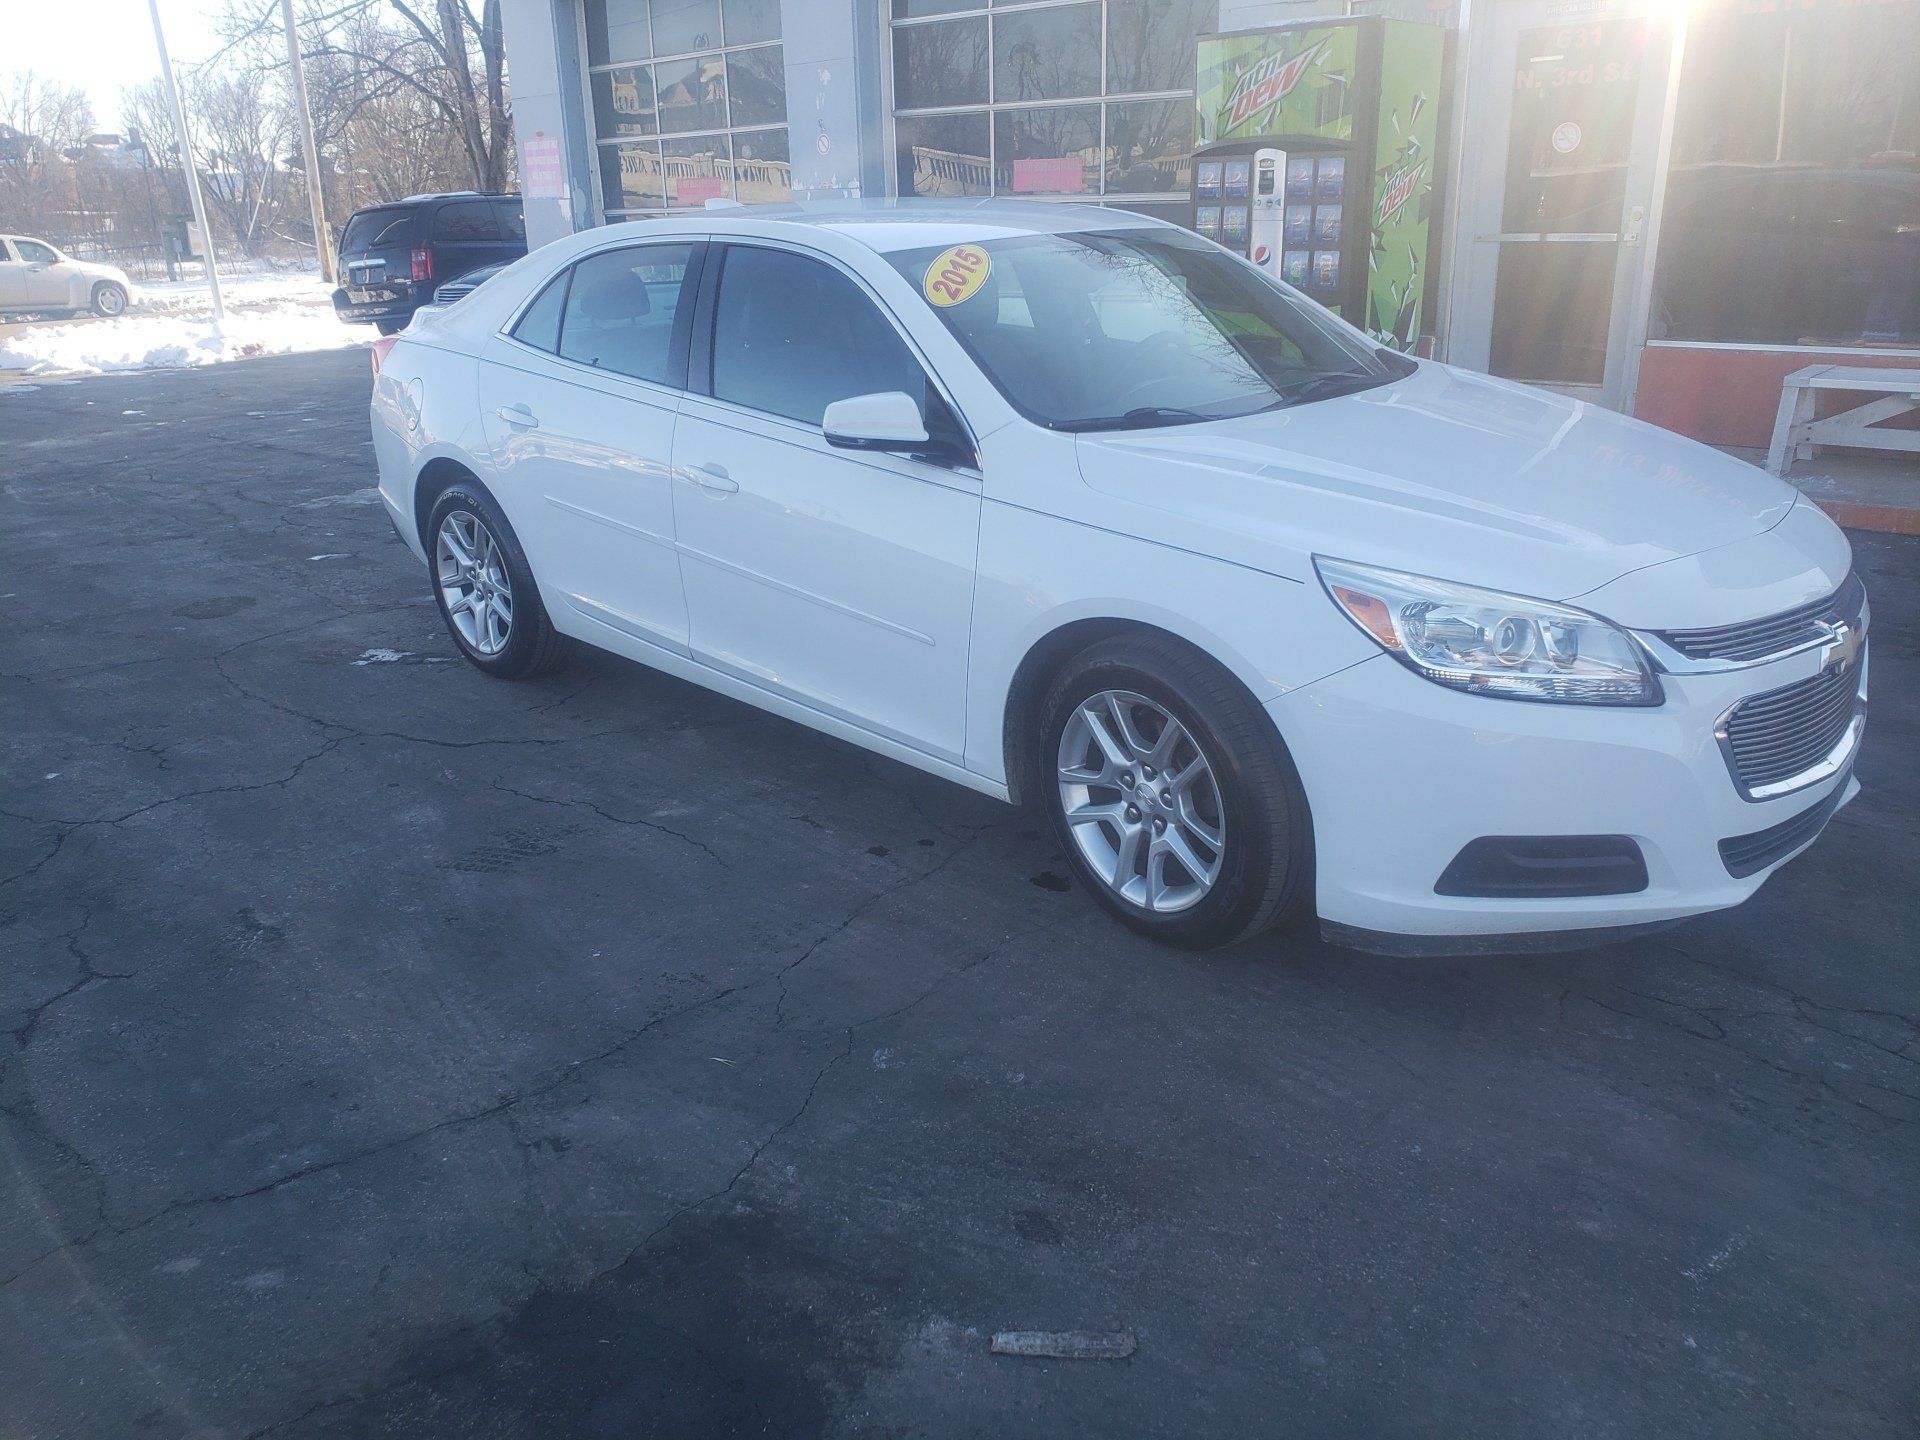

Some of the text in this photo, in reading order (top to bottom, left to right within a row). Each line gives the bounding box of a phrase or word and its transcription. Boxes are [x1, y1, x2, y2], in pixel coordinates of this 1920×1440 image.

[1516, 69, 1542, 89] N.
[1552, 63, 1595, 87] 3rd
[932, 247, 983, 301] 2015
